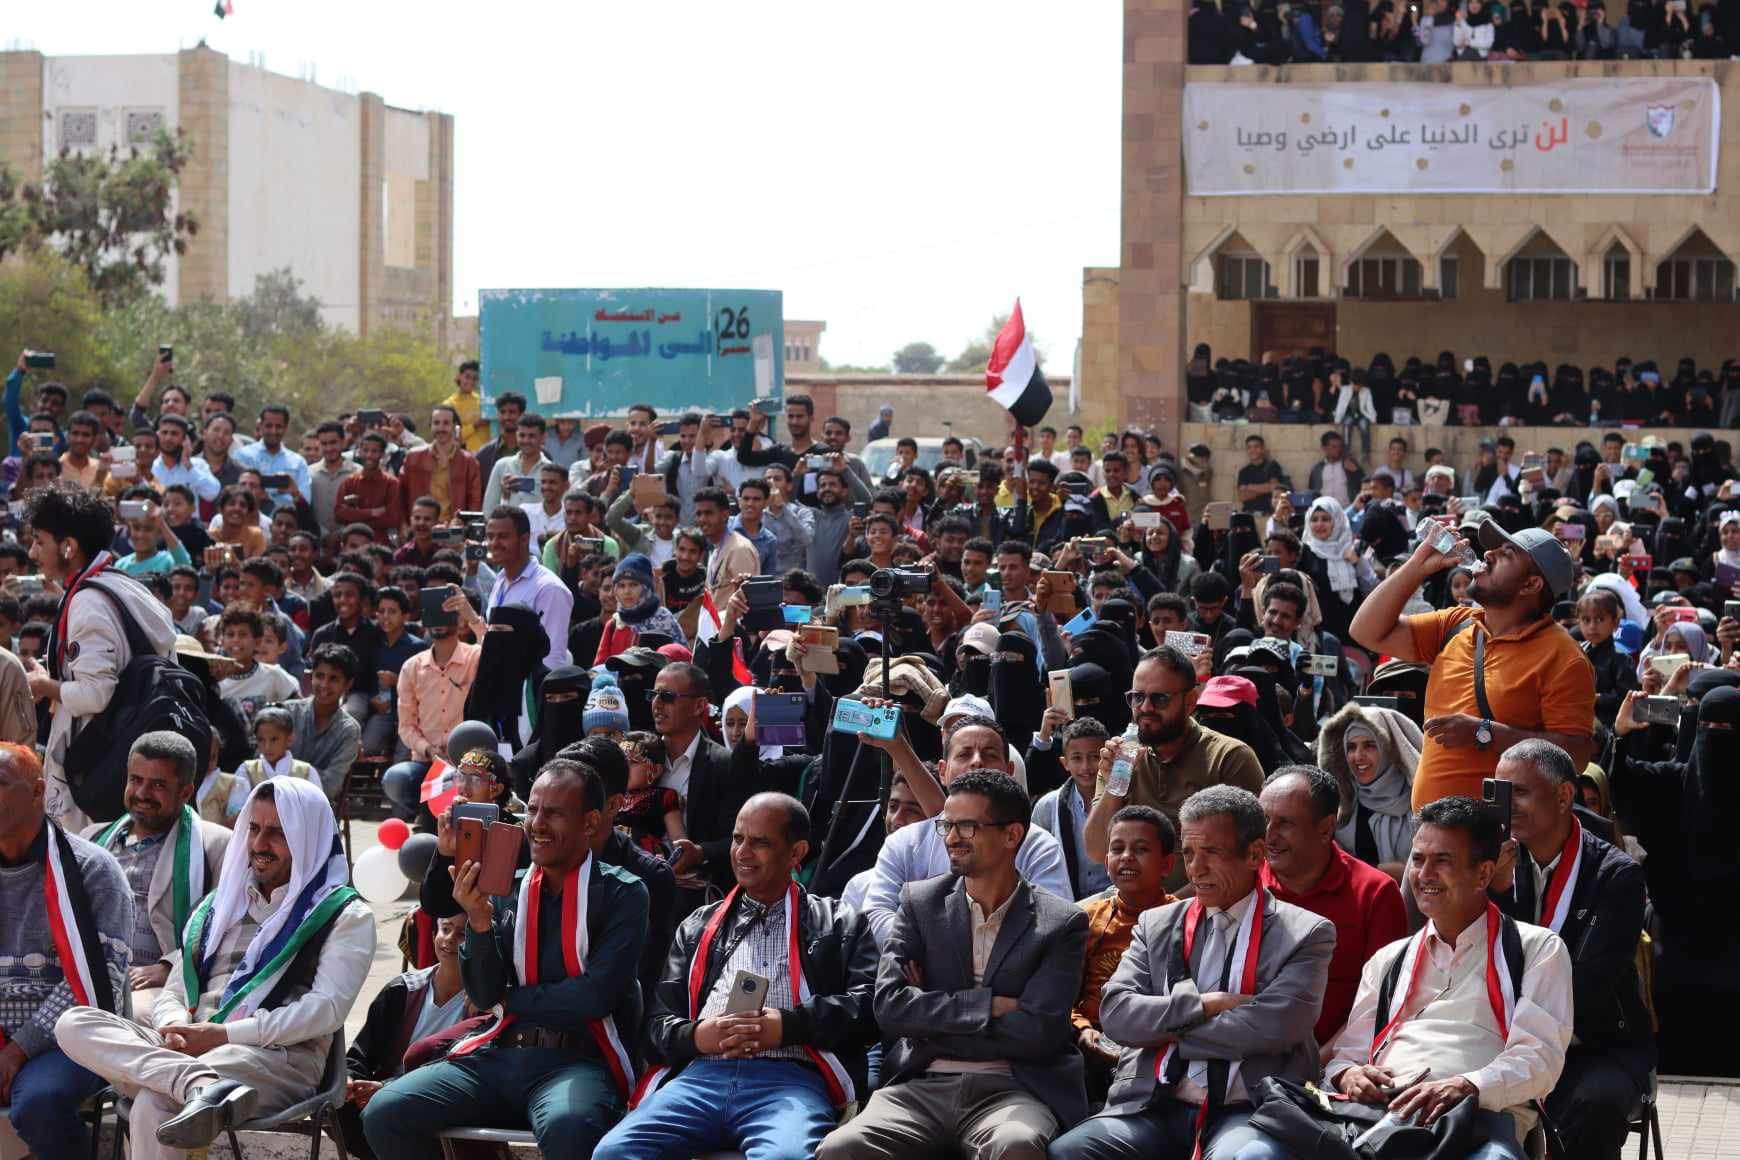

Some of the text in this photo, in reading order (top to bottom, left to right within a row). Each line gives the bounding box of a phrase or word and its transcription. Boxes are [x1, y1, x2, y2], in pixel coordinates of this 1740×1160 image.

[1236, 117, 1568, 157] لن ترى الدنيا على ارضي وصيا
[720, 305, 750, 339] 26
